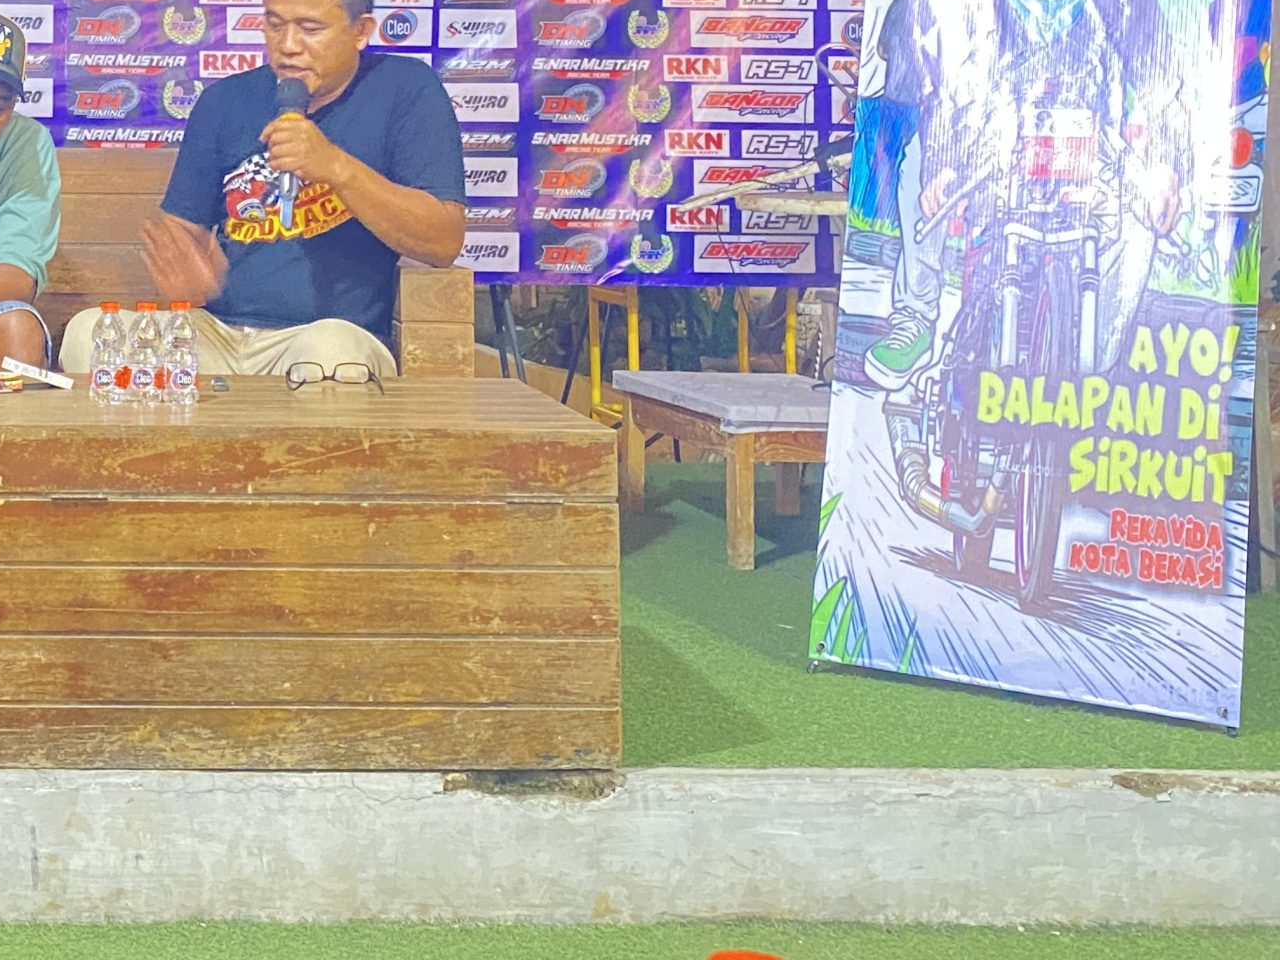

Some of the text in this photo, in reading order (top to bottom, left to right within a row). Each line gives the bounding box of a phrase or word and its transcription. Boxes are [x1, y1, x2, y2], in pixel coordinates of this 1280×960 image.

[386, 19, 411, 35] Cleo
[696, 15, 808, 34] BANGOR
[89, 34, 127, 44] TIMING
[554, 39, 592, 49] TIMING
[203, 53, 258, 71] RKN
[666, 58, 721, 75] RKN
[745, 60, 813, 80] RS-1
[698, 89, 807, 108] BANGOR
[89, 108, 127, 118] TIMING
[554, 113, 590, 123] TIMING
[668, 132, 724, 150] RKN
[746, 134, 814, 155] RS-1
[555, 188, 592, 197] TIMING
[670, 206, 724, 225] RKN
[746, 210, 813, 230] RS-1
[699, 240, 810, 259] BANGOR
[556, 263, 593, 273] TIMING
[1127, 322, 1241, 382] AYO!
[976, 371, 1167, 439] BALAPAN
[1068, 542, 1132, 577] KOTA
